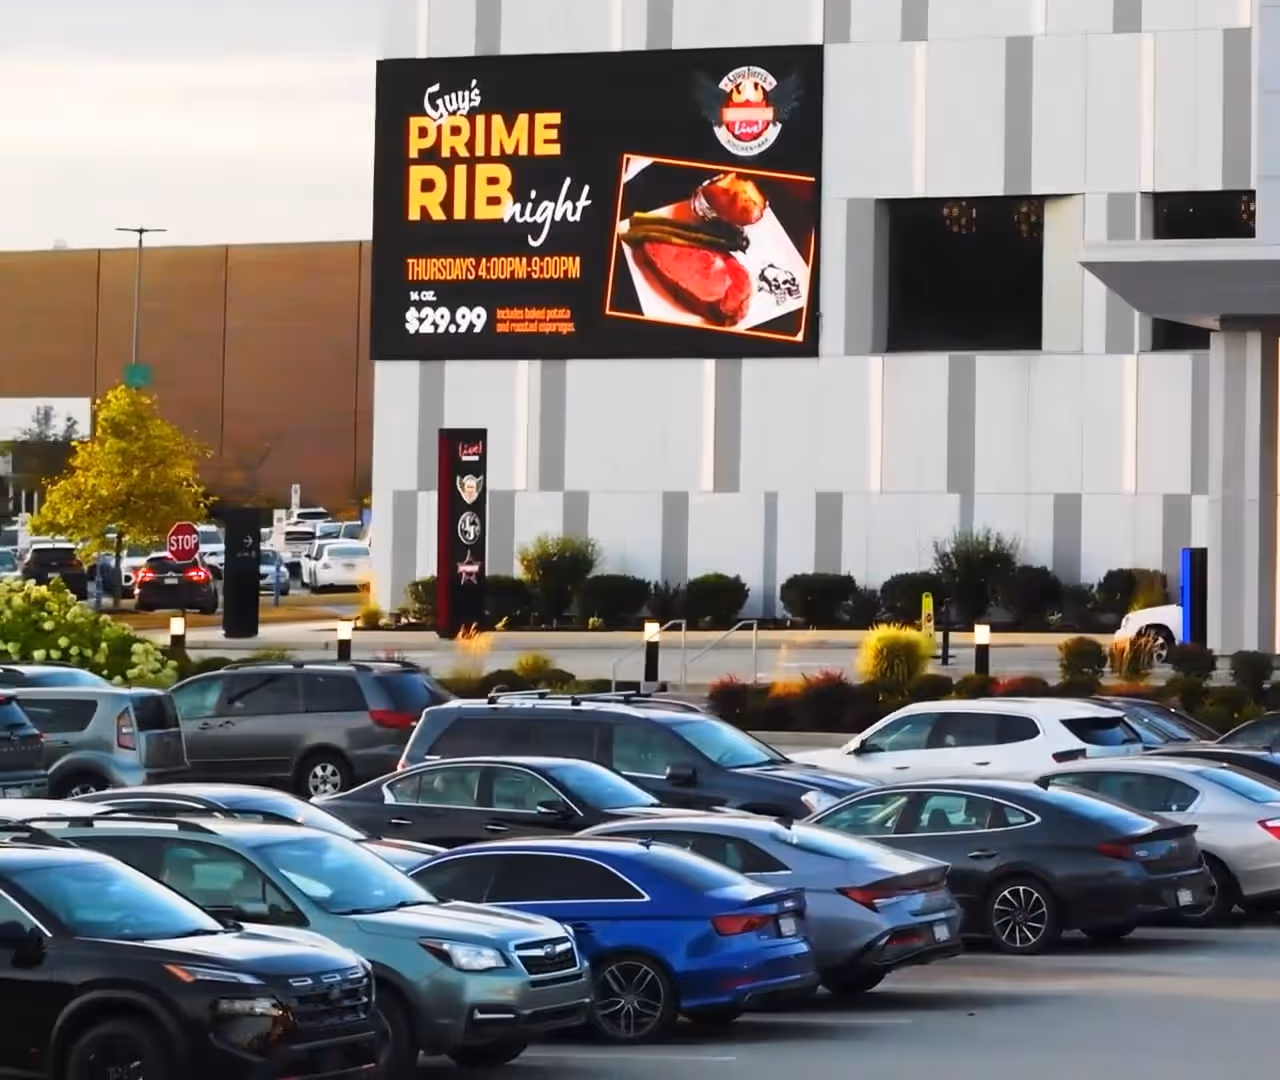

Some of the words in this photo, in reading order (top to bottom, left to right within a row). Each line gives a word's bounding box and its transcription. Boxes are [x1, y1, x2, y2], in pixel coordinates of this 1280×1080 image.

[423, 78, 482, 124] Guy's
[408, 112, 562, 159] PRIME
[408, 163, 514, 221] RIB
[503, 176, 592, 248] night
[406, 257, 476, 281] THURSDAYS
[478, 255, 581, 280] 4:00PM-9:00PM
[404, 305, 488, 334] $29.99
[170, 534, 199, 551] STOP
